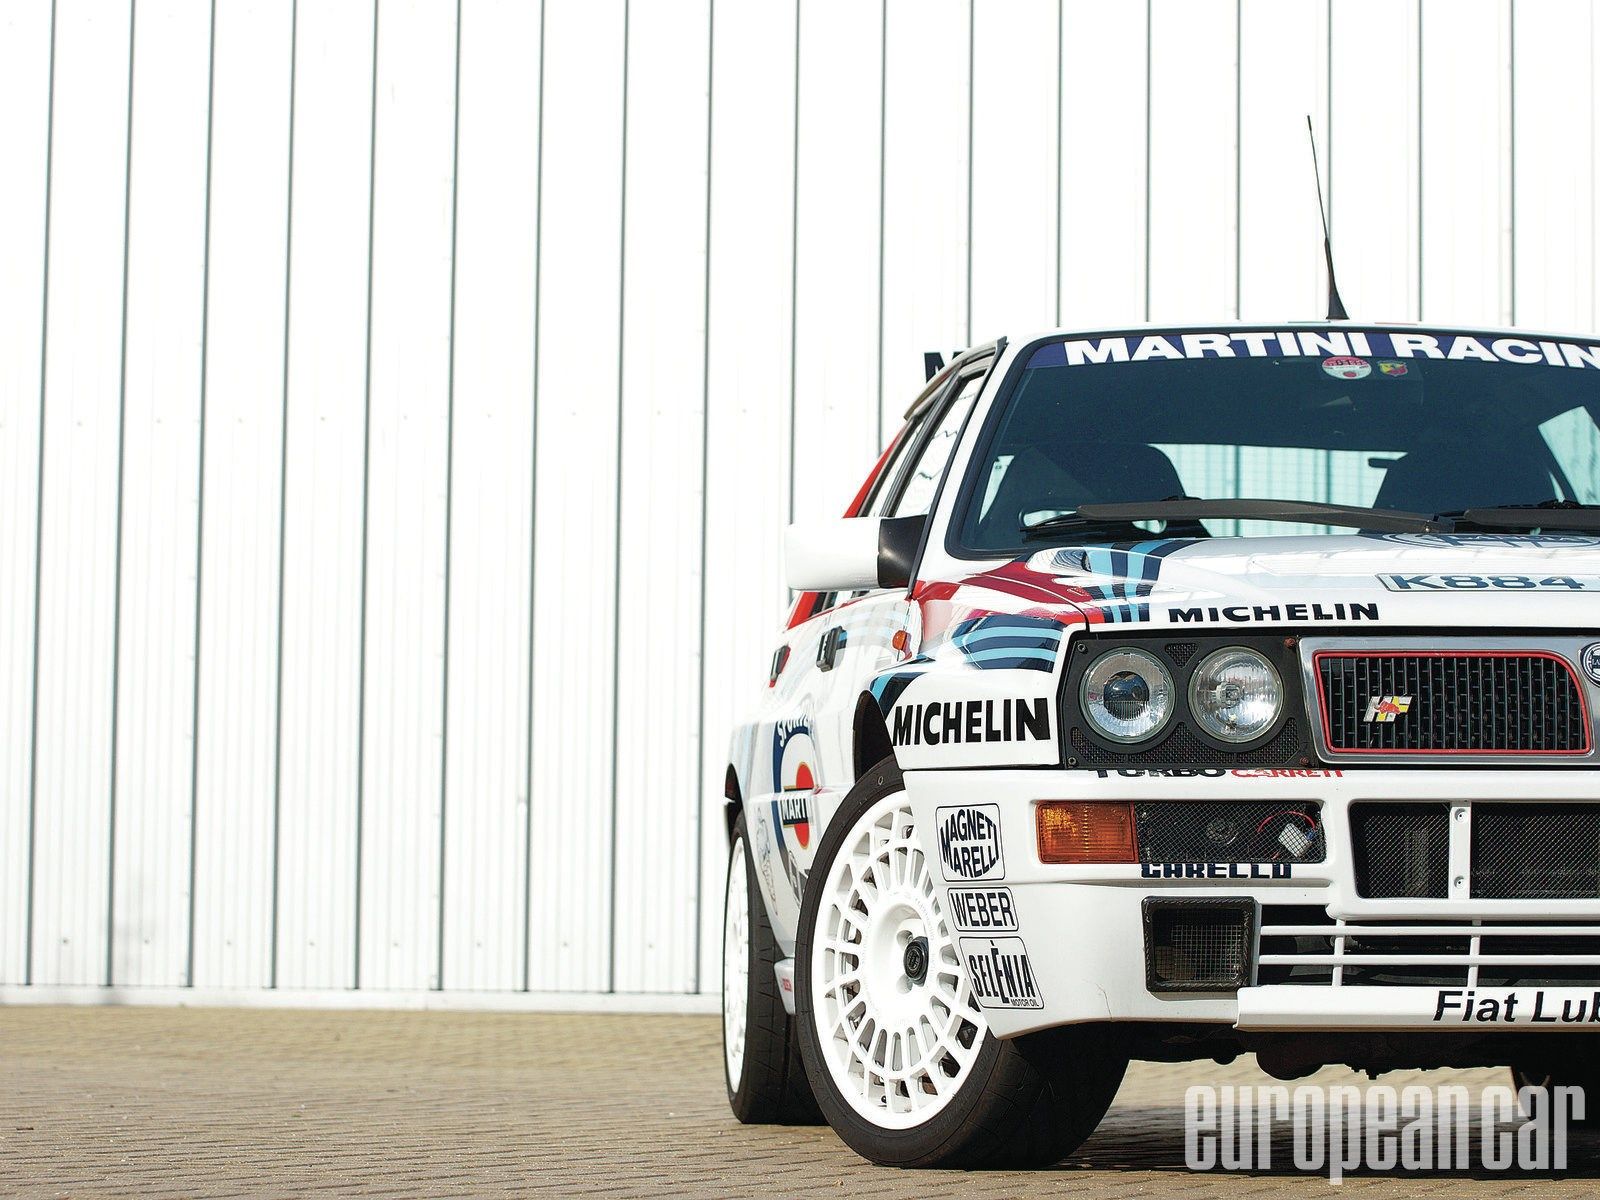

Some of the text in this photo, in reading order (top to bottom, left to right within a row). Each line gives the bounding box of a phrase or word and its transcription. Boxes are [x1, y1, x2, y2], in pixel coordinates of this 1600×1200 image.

[1064, 332, 1373, 366] MARTINI
[1391, 575, 1585, 590] K884
[1168, 603, 1379, 623] MICHELIN
[892, 697, 1051, 746] MICHELIN
[950, 892, 1016, 927] WEBER
[1010, 999, 1040, 1007] MOTOR OIL
[1433, 991, 1518, 1022] Fiat
